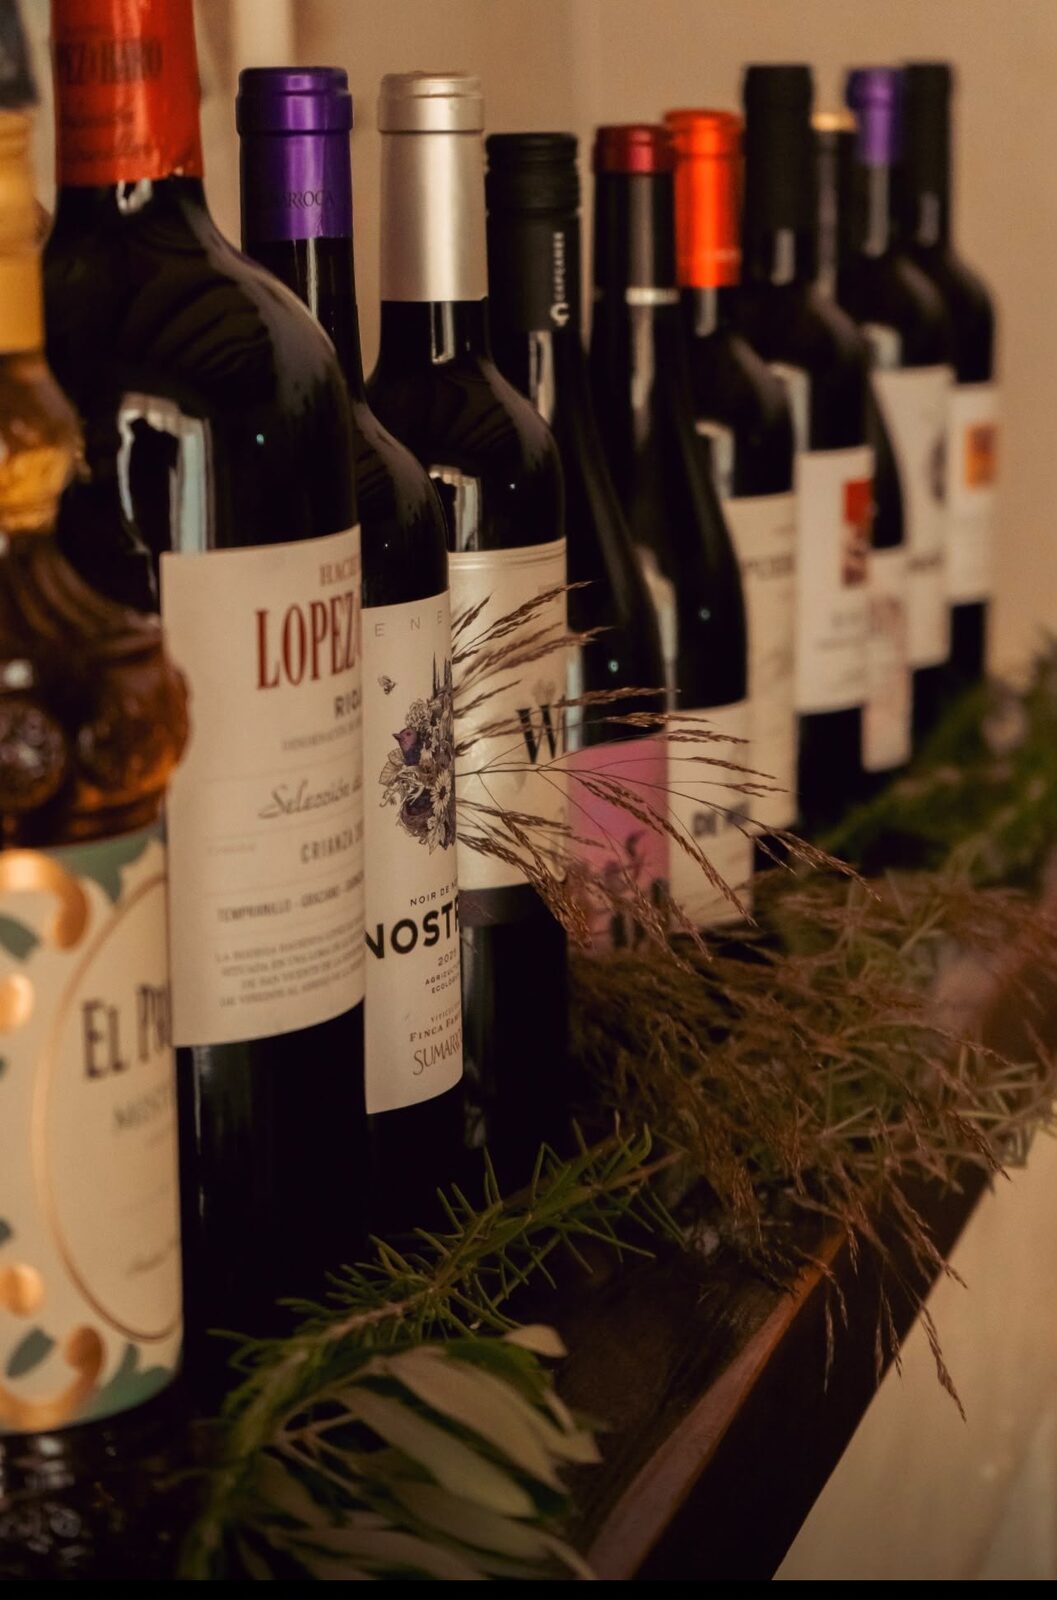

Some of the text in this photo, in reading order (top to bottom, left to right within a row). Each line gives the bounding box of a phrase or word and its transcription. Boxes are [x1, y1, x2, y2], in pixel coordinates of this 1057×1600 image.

[255, 591, 356, 690] LOPEZ
[410, 891, 437, 908] NOIR
[440, 885, 450, 897] DE
[410, 1025, 443, 1043] FINCA
